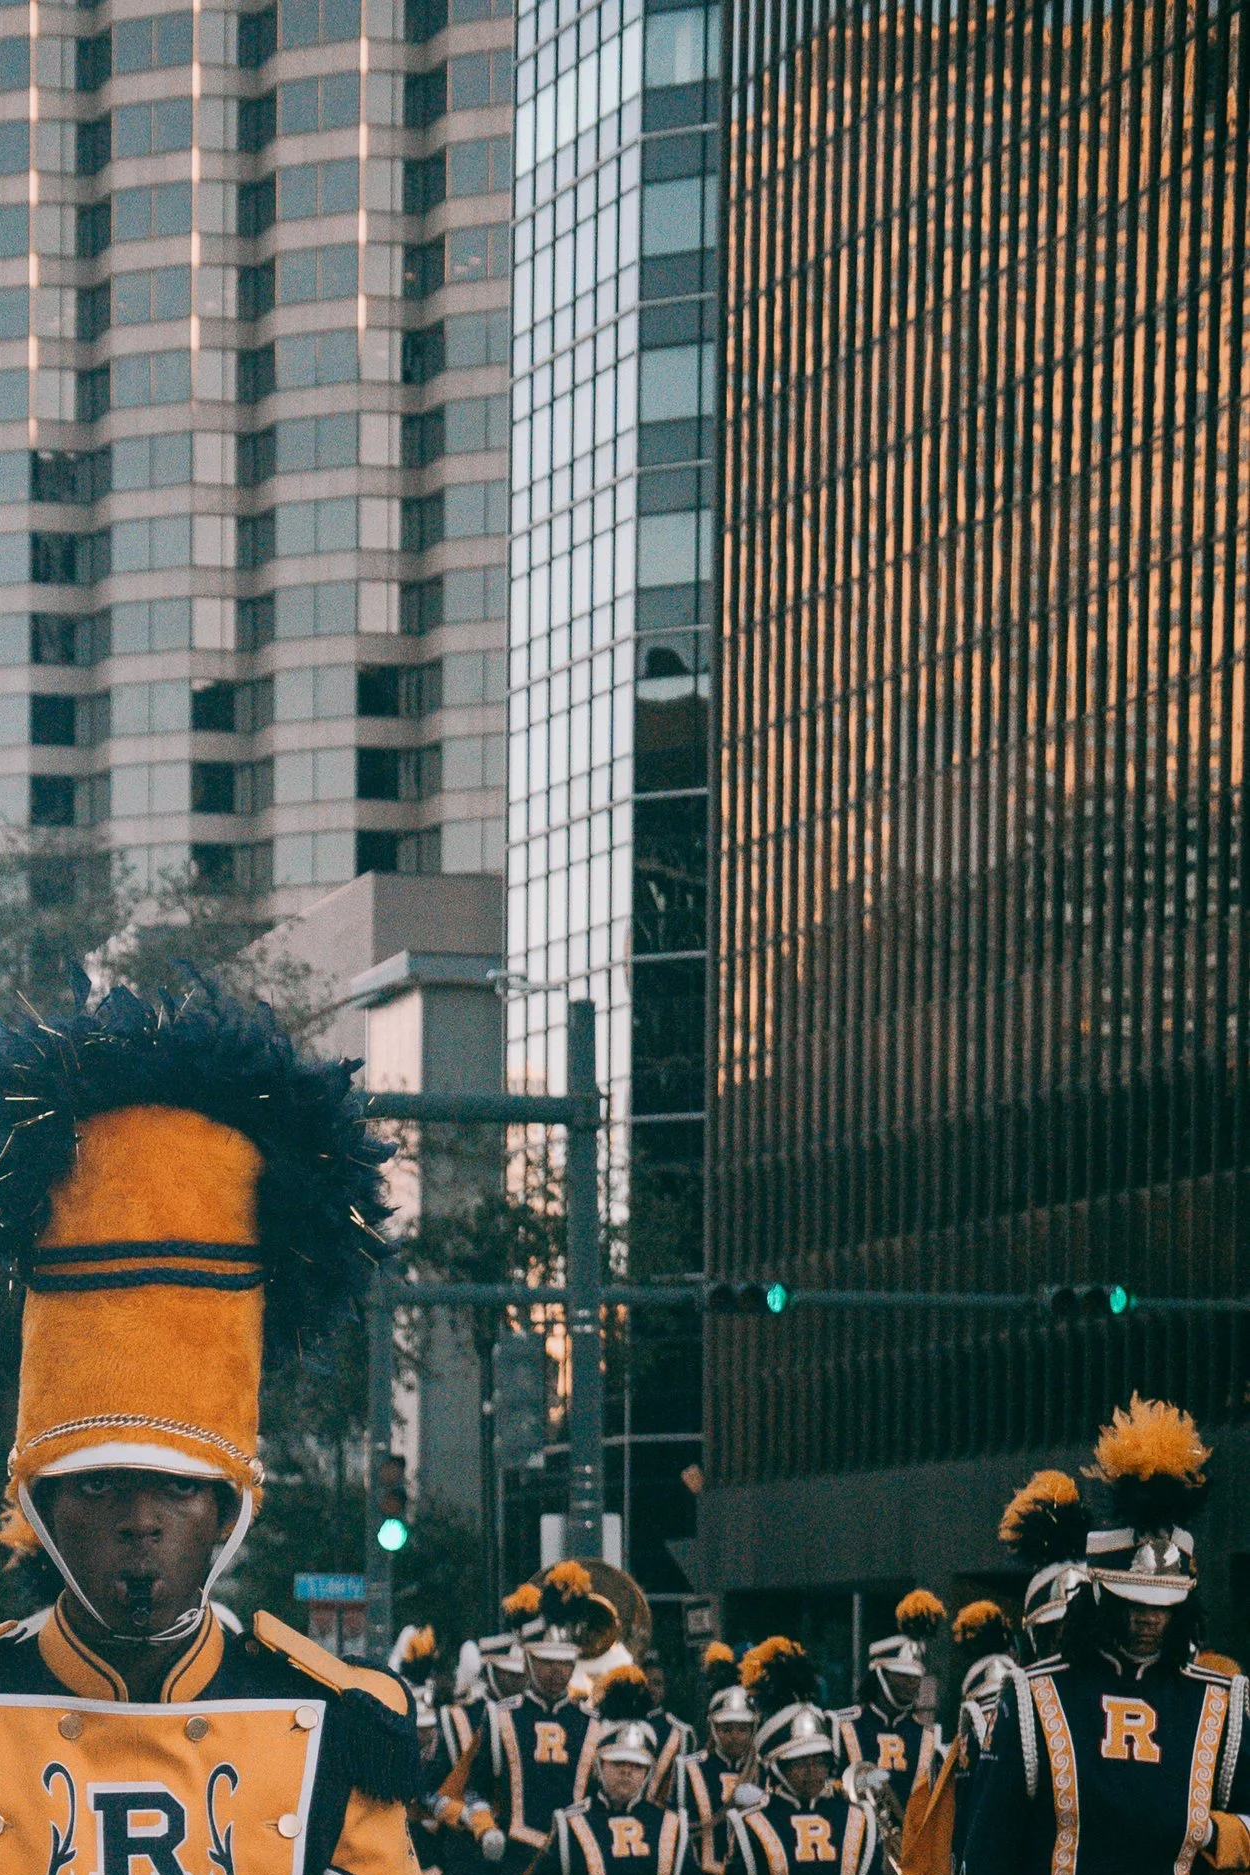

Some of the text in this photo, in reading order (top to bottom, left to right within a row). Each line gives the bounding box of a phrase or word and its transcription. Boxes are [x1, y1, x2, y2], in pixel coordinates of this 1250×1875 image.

[534, 1721, 569, 1764] R
[1101, 1693, 1160, 1763] R
[877, 1733, 908, 1771] R
[608, 1816, 650, 1858] R
[790, 1814, 837, 1862] R
